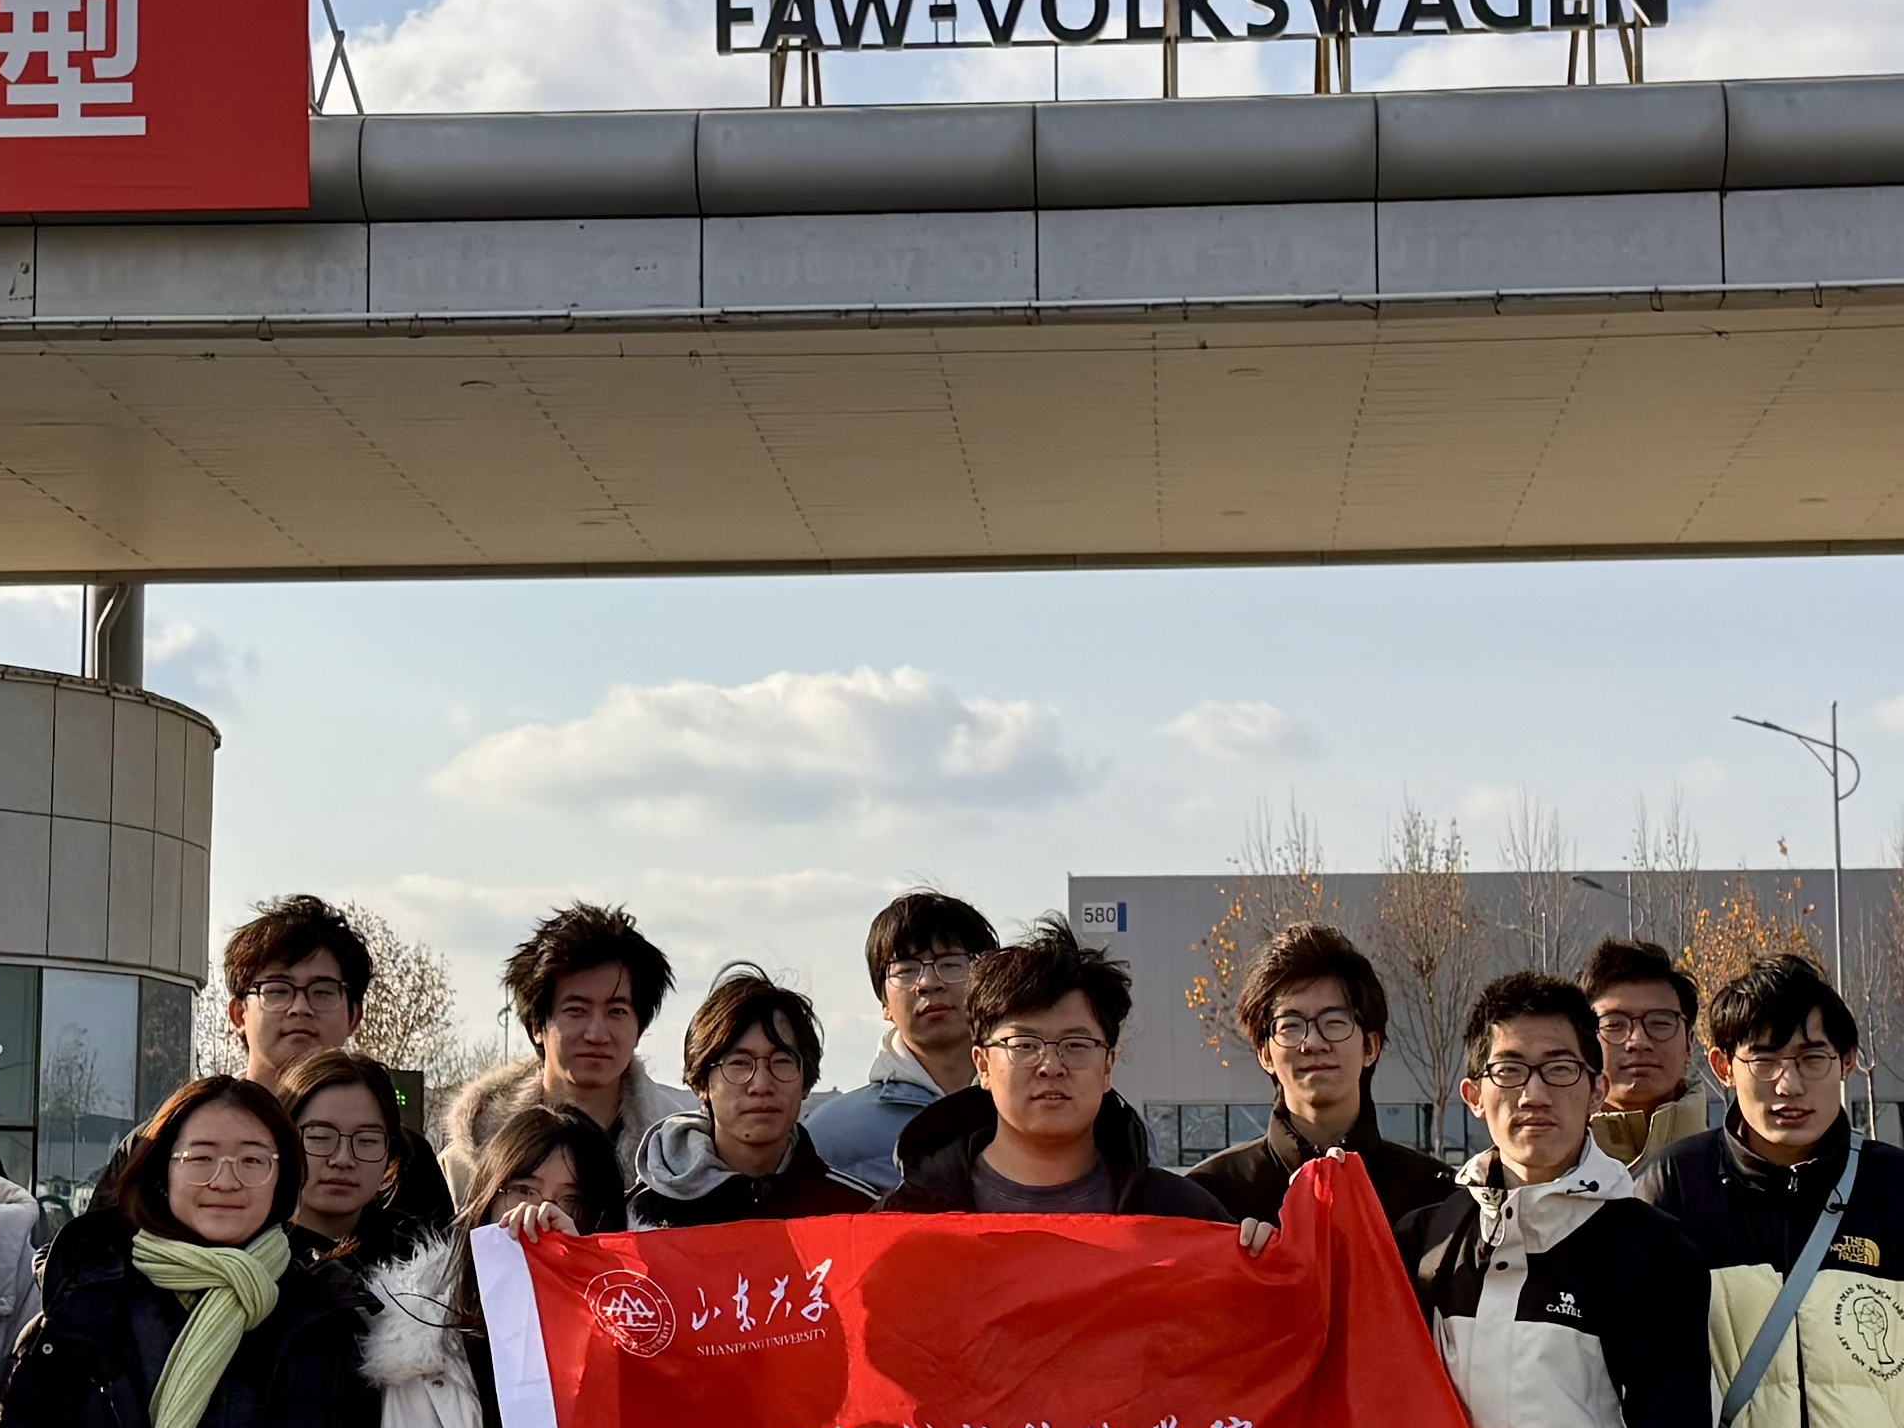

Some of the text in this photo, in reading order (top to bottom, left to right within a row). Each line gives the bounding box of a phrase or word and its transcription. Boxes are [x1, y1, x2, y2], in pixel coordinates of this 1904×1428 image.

[1084, 907, 1116, 923] 580
[1843, 1235, 1865, 1245] THE
[692, 1258, 833, 1332] 山东大学
[1546, 1303, 1583, 1318] CAMEL
[765, 1328, 828, 1347] UNIVERSITY
